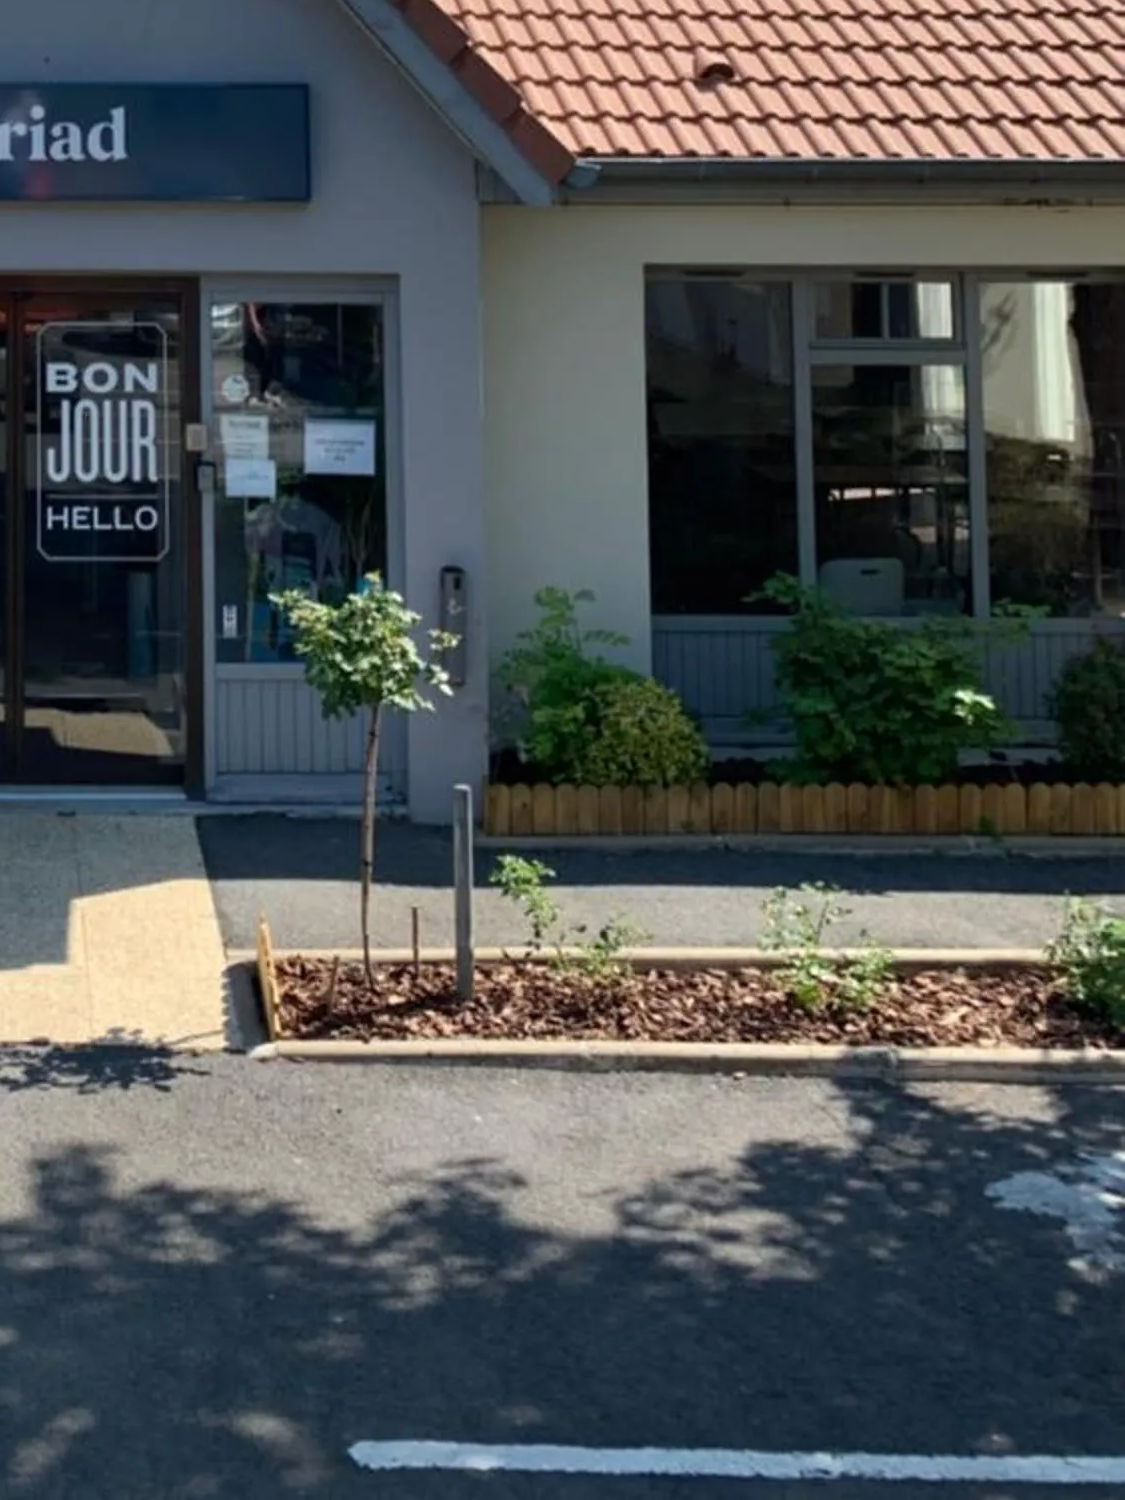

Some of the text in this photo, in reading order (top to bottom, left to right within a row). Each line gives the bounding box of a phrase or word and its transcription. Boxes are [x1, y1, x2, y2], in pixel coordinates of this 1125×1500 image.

[46, 362, 158, 393] BON
[47, 399, 158, 482] JOUR
[46, 505, 159, 531] HELLO
